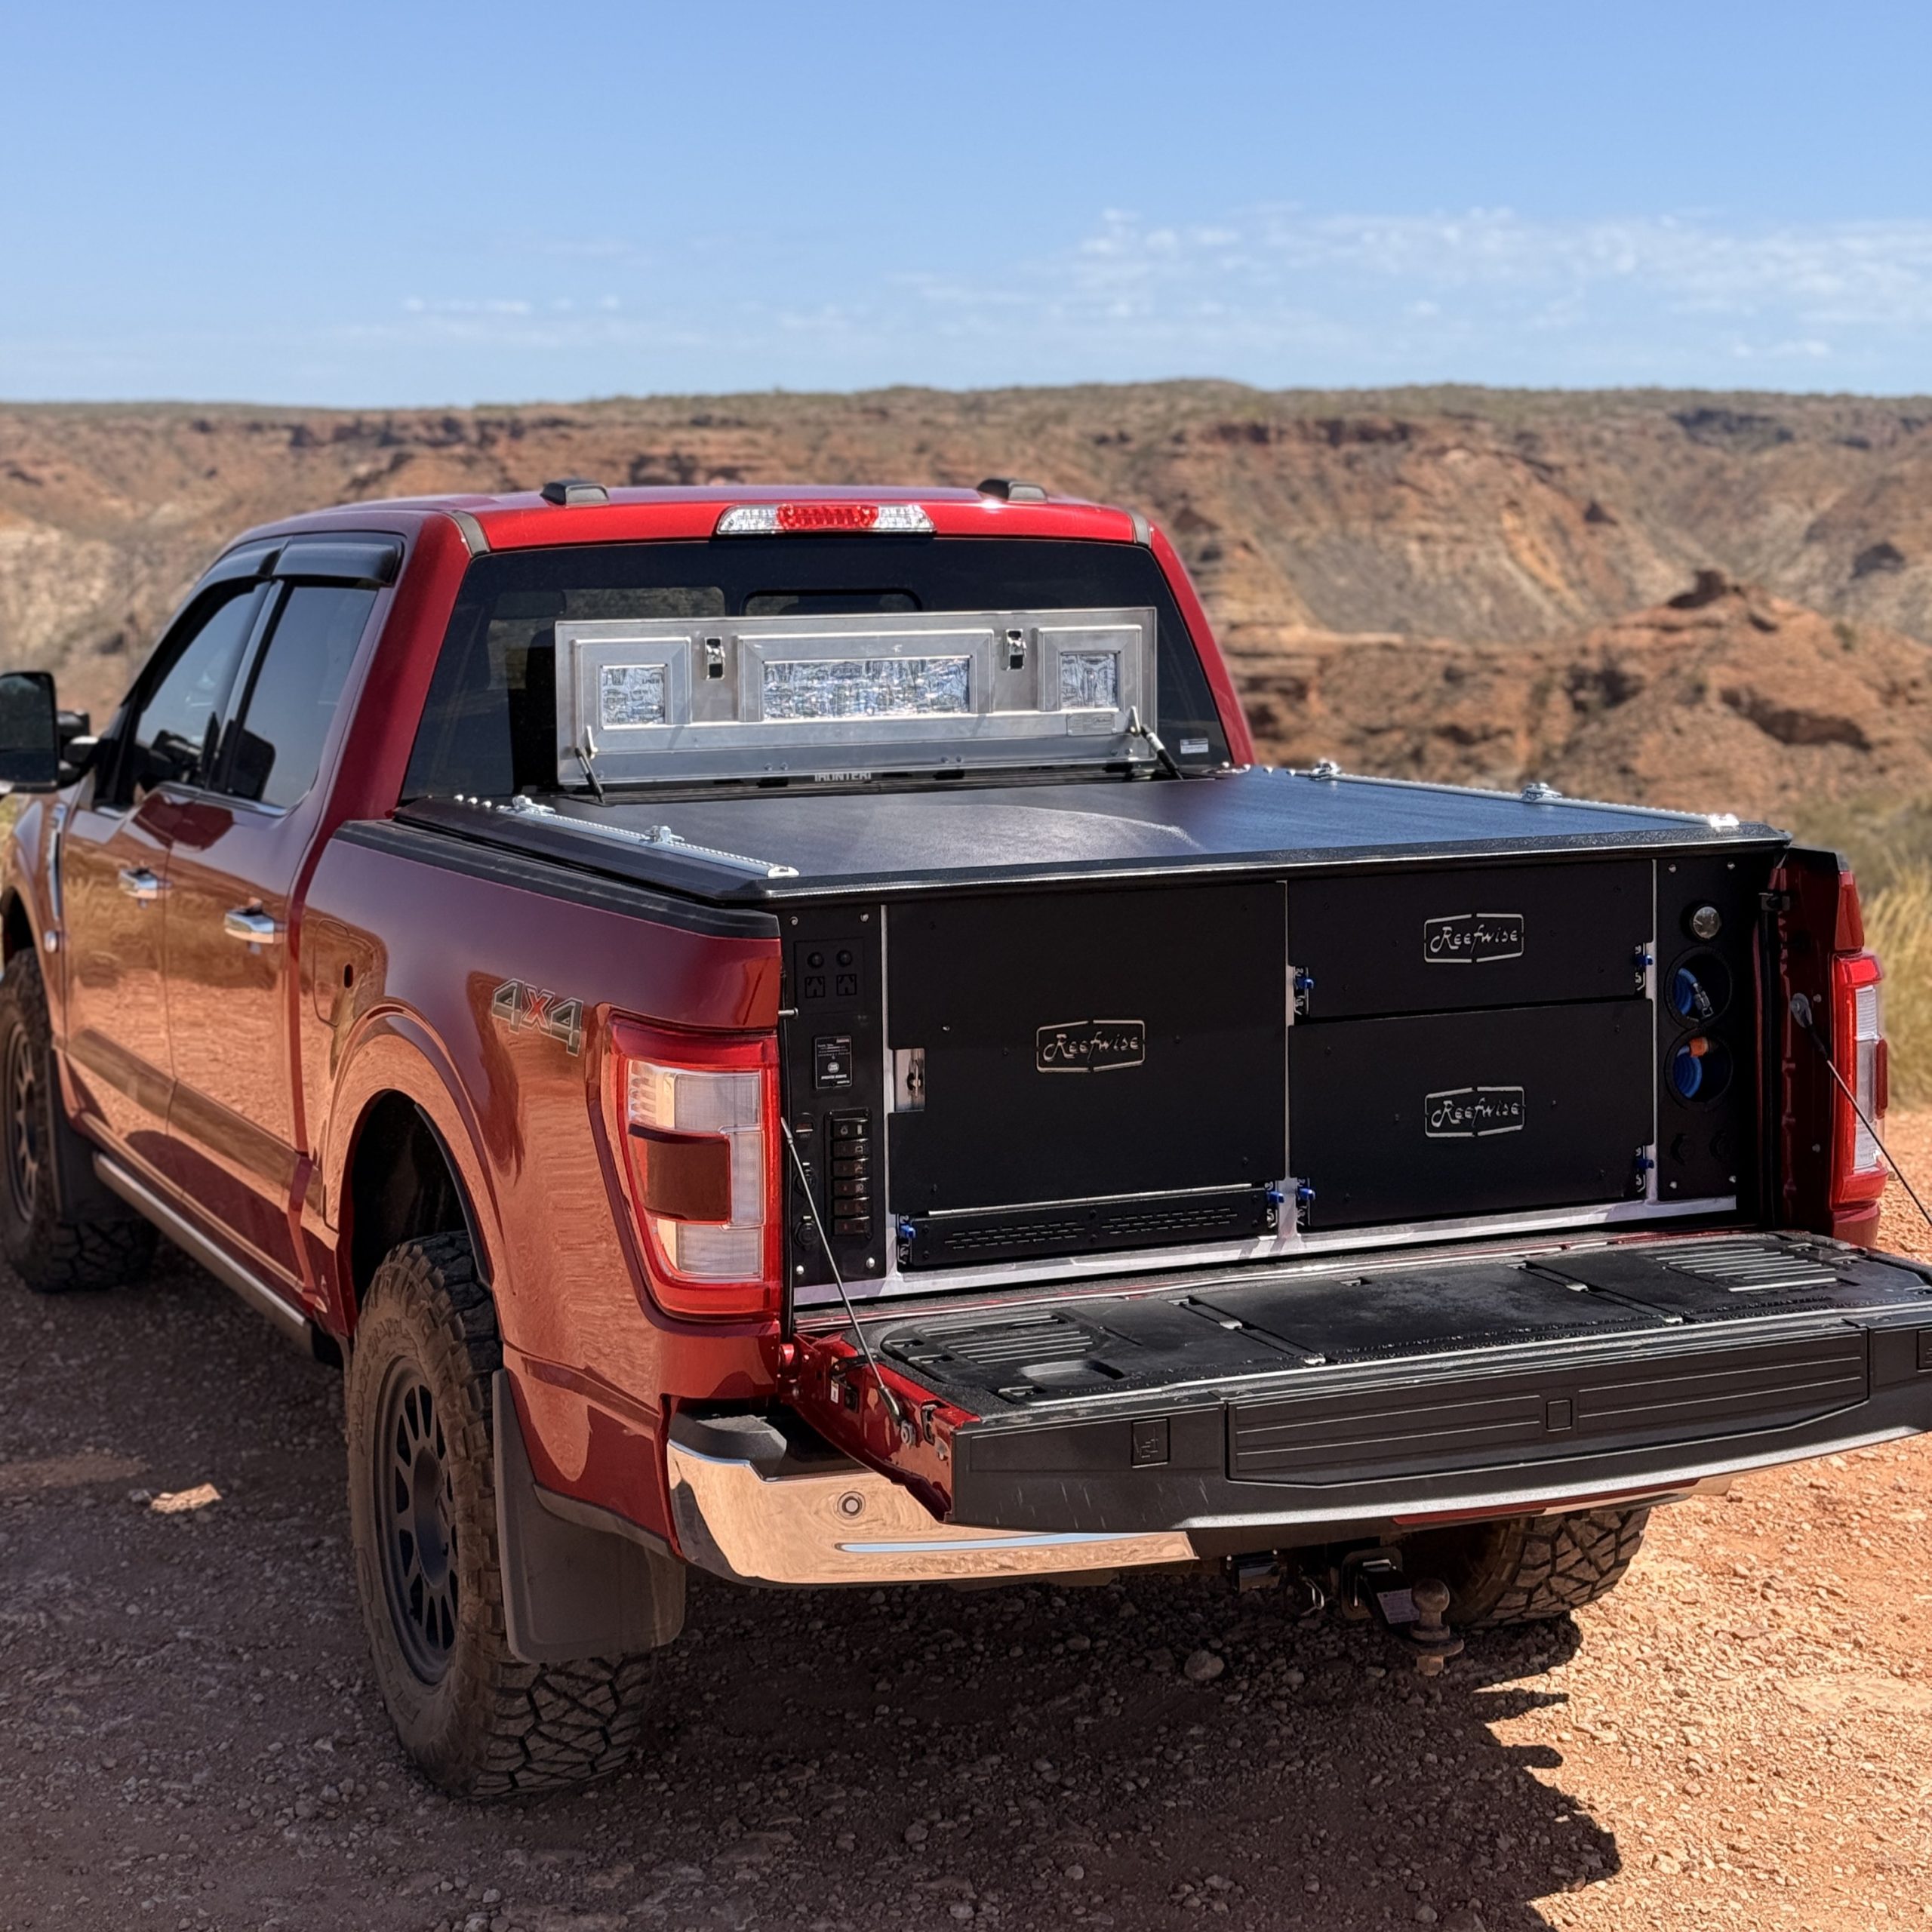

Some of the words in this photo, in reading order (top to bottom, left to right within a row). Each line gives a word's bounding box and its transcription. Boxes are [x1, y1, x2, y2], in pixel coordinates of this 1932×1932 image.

[1429, 924, 1518, 953] Reefwise
[1043, 1031, 1139, 1063] Reefwise
[1431, 1097, 1519, 1128] Reefwise
